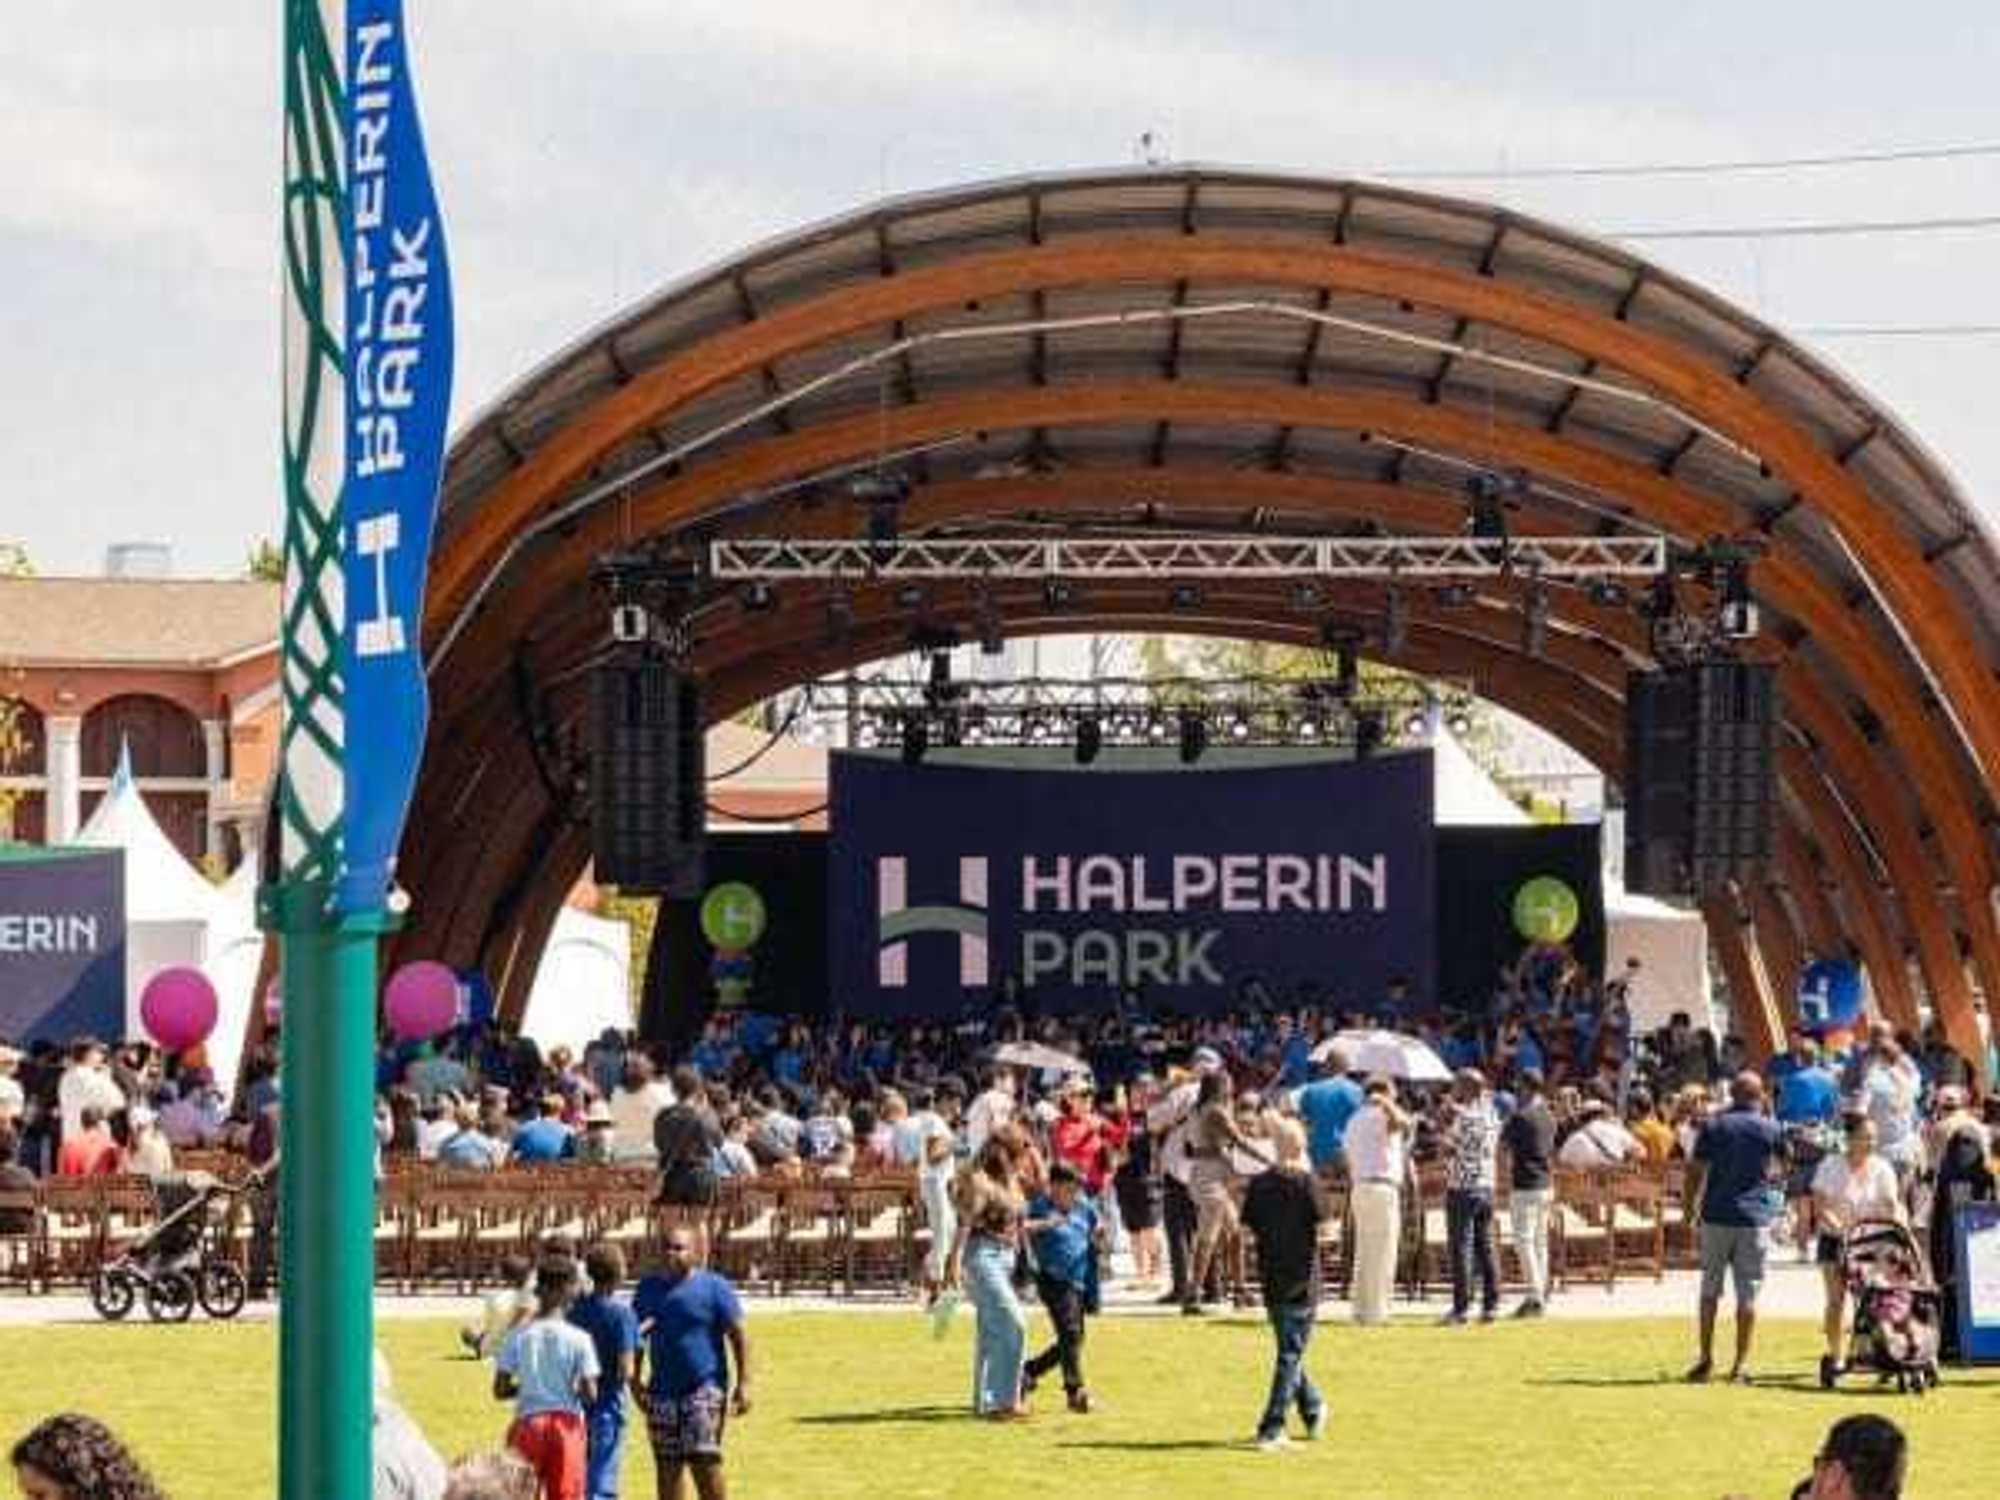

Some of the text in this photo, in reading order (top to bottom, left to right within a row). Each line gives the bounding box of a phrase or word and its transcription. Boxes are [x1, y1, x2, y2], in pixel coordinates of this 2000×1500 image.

[375, 218, 430, 470] PARK
[1022, 855, 1388, 912] HALPERIN
[0, 915, 97, 952] ERIN
[879, 856, 988, 986] H
[1022, 930, 1224, 986] PARK
